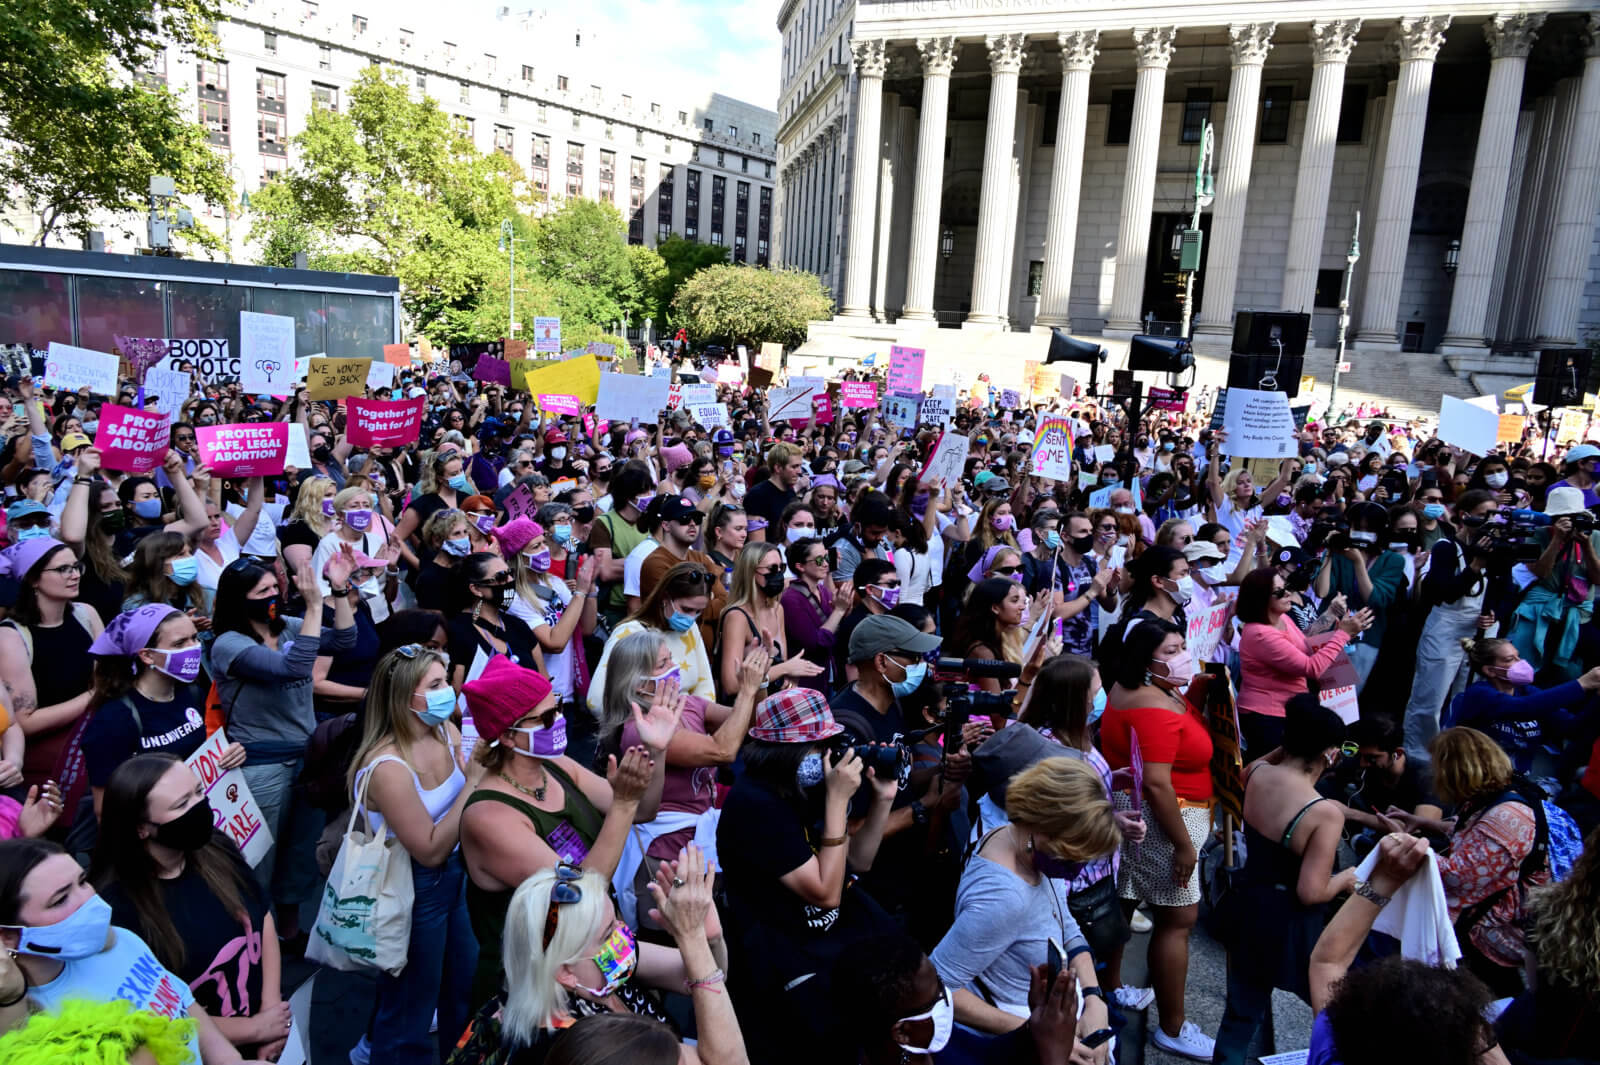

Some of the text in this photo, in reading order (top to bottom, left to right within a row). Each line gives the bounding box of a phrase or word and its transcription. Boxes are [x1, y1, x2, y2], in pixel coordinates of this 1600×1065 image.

[169, 340, 227, 358] BODY
[170, 359, 241, 376] CHOIC
[312, 363, 363, 375] WE WON'T
[323, 374, 361, 386] GO BACK
[925, 399, 942, 408] KEEP
[356, 406, 405, 420] Together
[698, 408, 721, 417] EQUAL
[921, 408, 950, 416] ABORTION
[926, 415, 940, 423] SAFE
[122, 413, 170, 431] PROTE
[358, 417, 415, 432] Fight for All
[1042, 415, 1073, 438] RUTH
[106, 423, 150, 442] SAFE,
[216, 428, 273, 440] PROTECT
[207, 439, 282, 452] SAFE, LEGAL
[1046, 433, 1065, 447] SENT
[214, 449, 277, 463] ABORTION
[1046, 448, 1065, 464] ME
